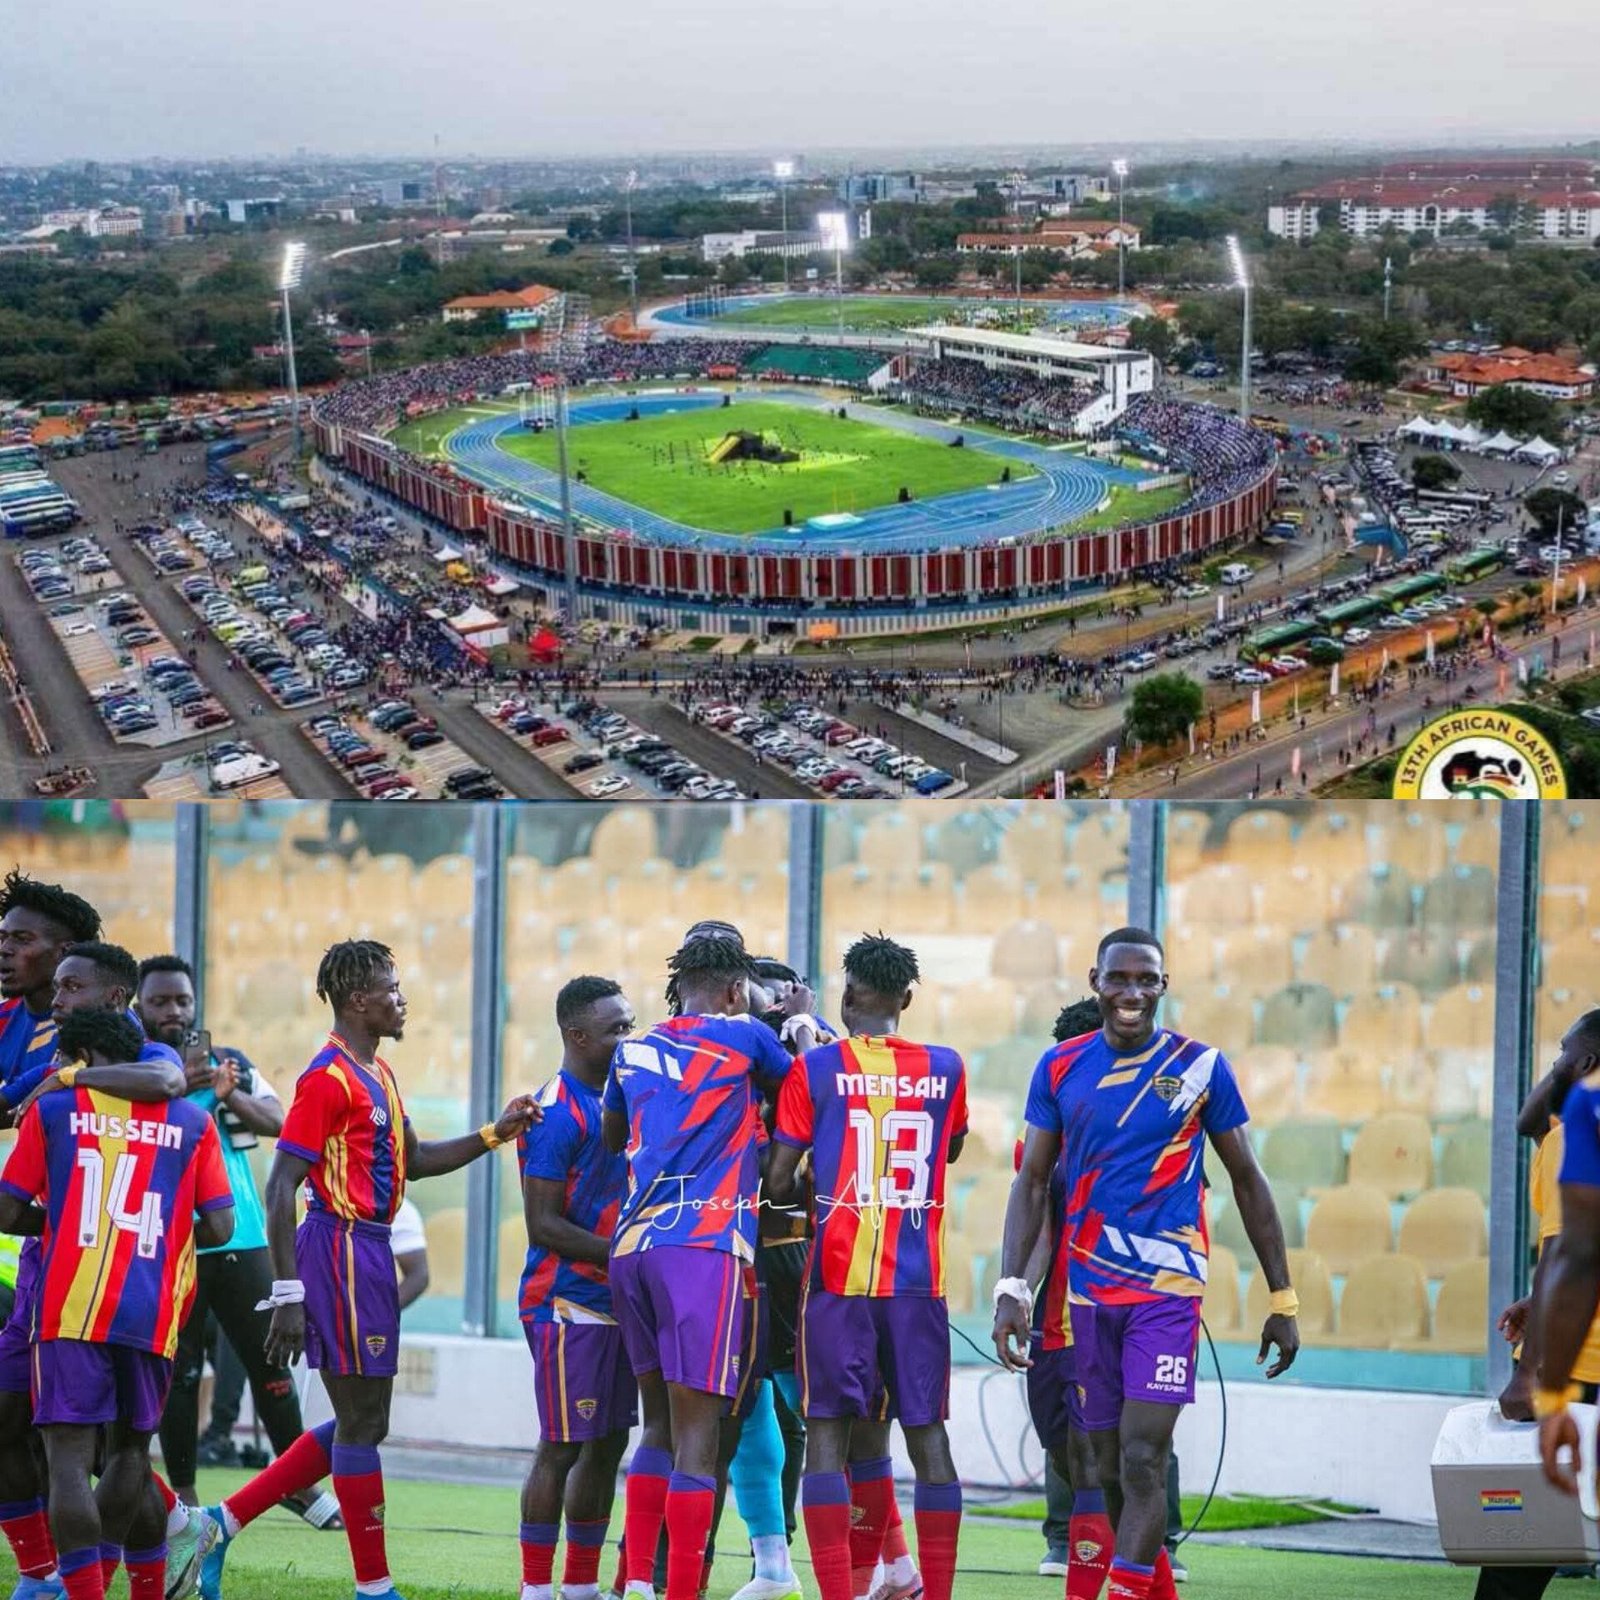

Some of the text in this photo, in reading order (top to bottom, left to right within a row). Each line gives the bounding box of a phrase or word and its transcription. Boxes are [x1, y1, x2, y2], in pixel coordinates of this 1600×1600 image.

[835, 1072, 948, 1100] MENSAH
[69, 1111, 183, 1150] HUSSEIN
[848, 1108, 934, 1208] 13
[77, 1147, 164, 1260] 14
[1155, 1354, 1188, 1385] 26
